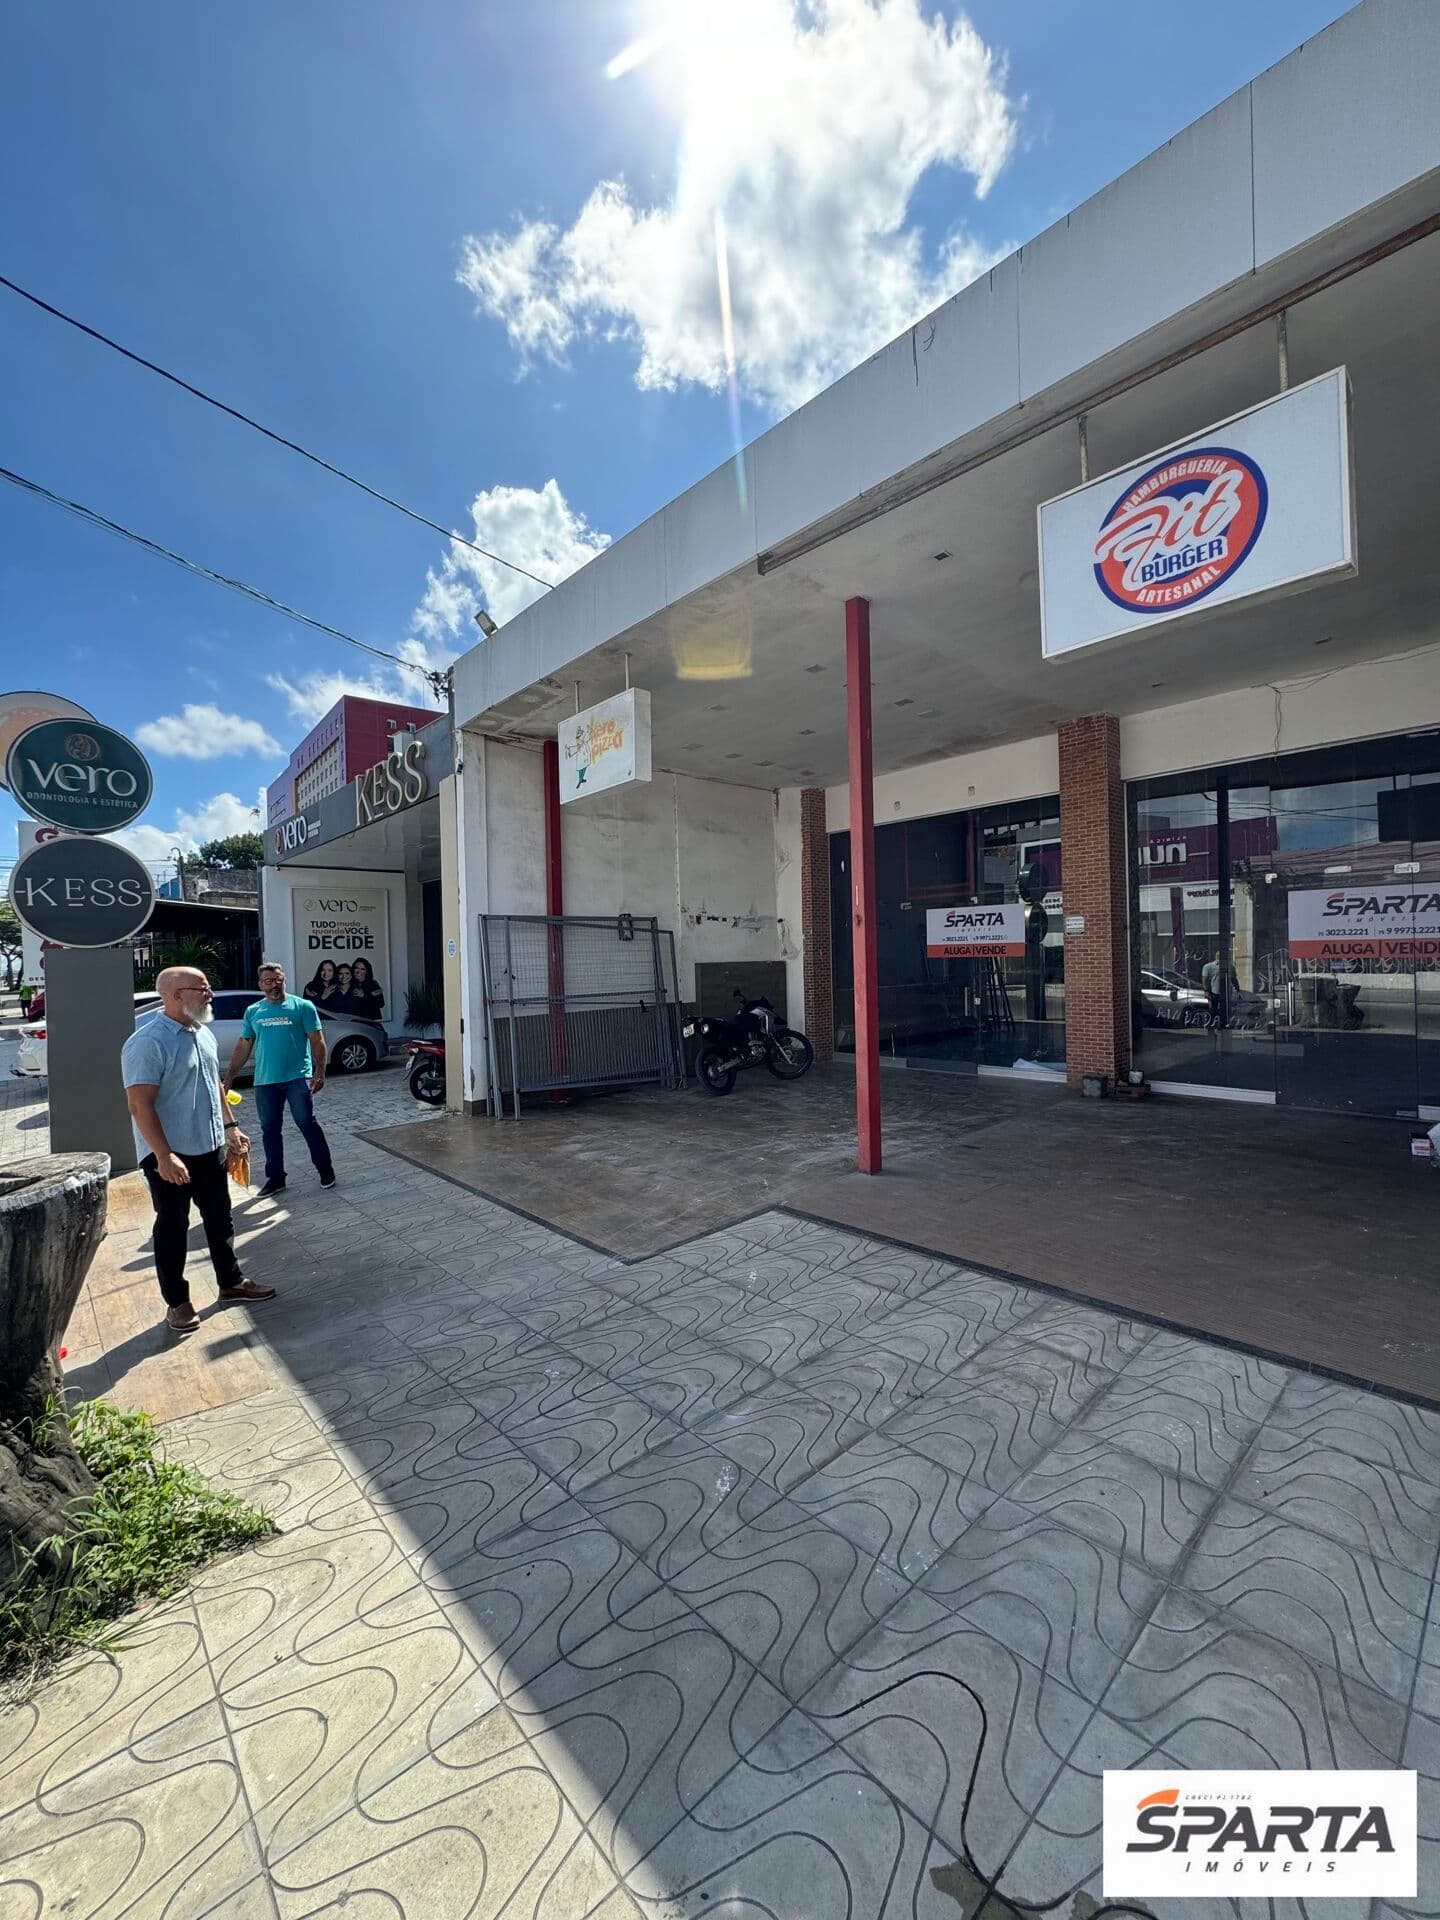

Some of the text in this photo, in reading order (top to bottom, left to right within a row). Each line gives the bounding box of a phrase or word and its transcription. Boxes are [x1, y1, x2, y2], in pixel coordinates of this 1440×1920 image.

[1122, 458, 1228, 512] HAMBURGUERIA
[1141, 539, 1223, 583] BURGER
[1136, 565, 1222, 603] ARTESANAL
[26, 758, 138, 797] vero
[355, 741, 427, 827] KESS
[26, 791, 89, 804] ODONTOLOGIA
[282, 815, 307, 852] vero
[24, 877, 143, 907] KESS
[318, 899, 358, 912] vero
[1322, 894, 1440, 917] SPARTA
[310, 920, 361, 928] TUDO muda
[944, 912, 1004, 928] SPARTA
[312, 926, 369, 936] quando VOCÊ
[1326, 928, 1369, 937] 3023.2221
[943, 946, 971, 955] ALUGA
[975, 945, 1007, 955] VENDE
[1321, 943, 1374, 955] ALUGA
[1386, 941, 1440, 954] VEND
